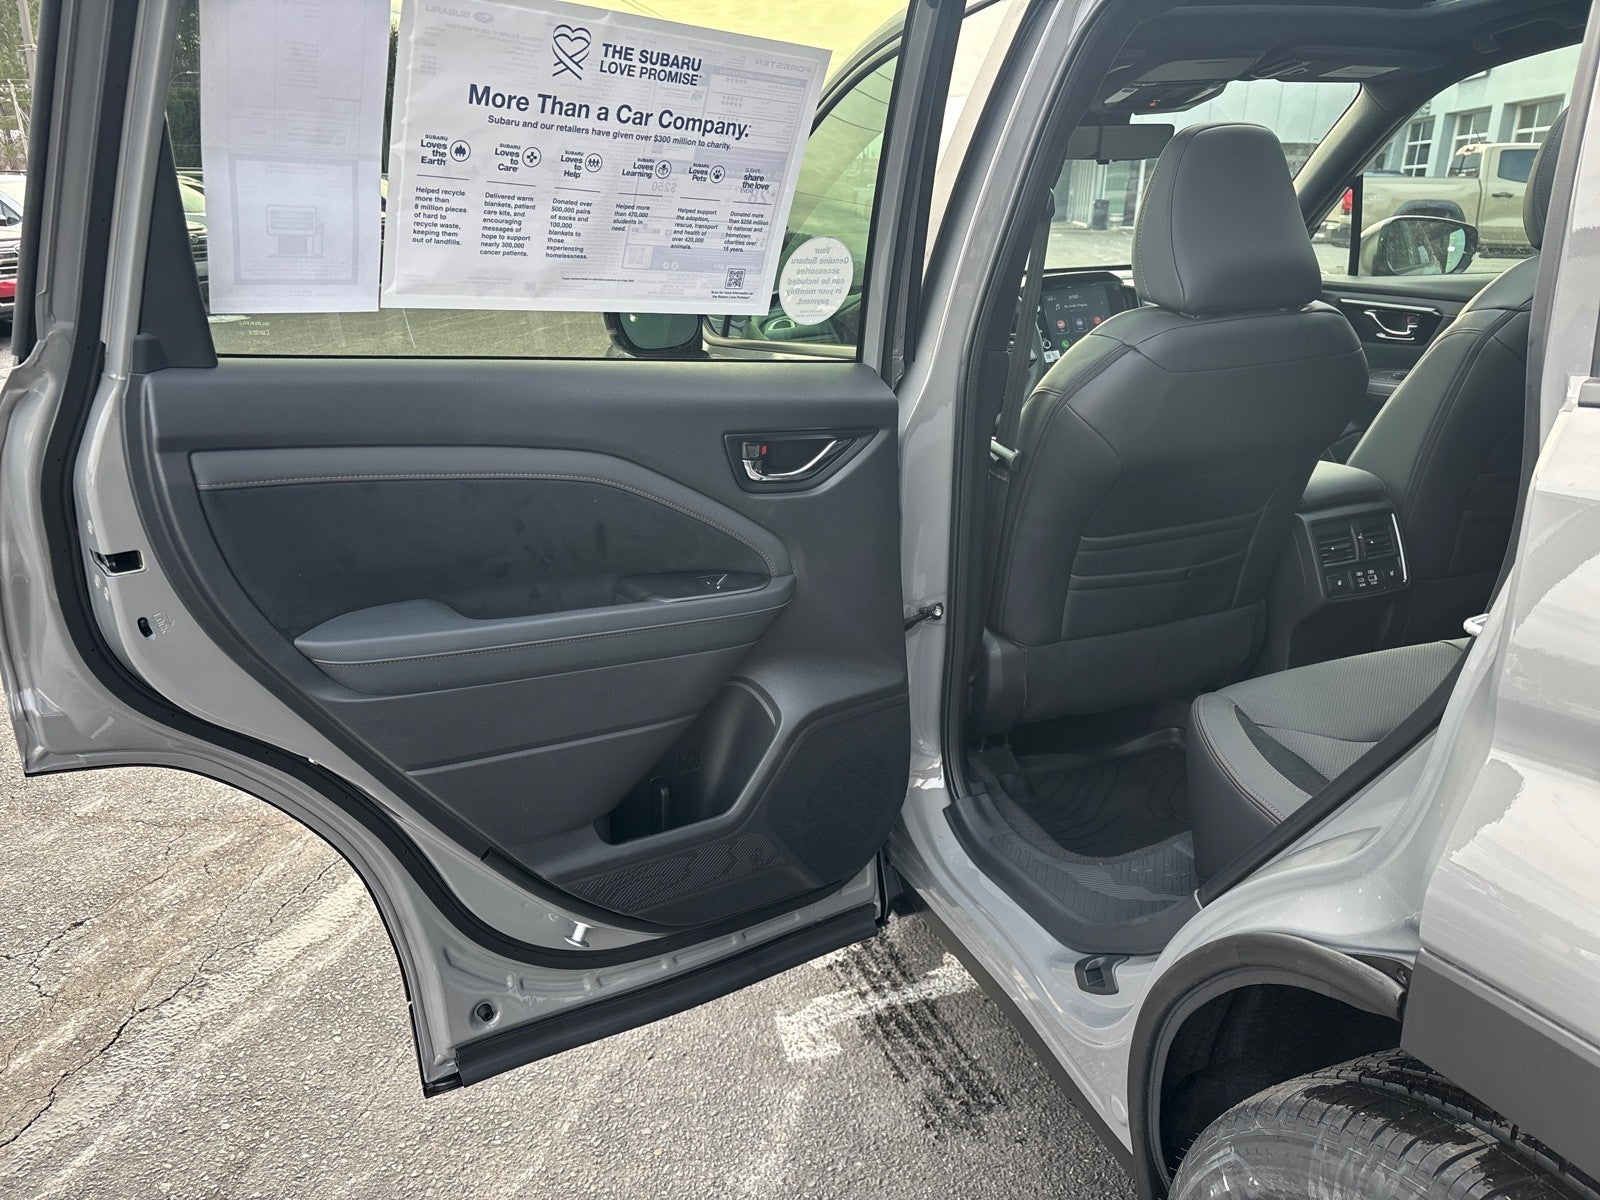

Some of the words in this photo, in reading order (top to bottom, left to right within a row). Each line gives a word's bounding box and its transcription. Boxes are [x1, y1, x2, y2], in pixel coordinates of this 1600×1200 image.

[602, 42, 635, 61] THE
[638, 49, 702, 72] SUBARU
[599, 61, 636, 78] LOVE
[468, 83, 530, 112] More
[537, 92, 590, 119] Than
[596, 105, 609, 122] a
[615, 103, 653, 127] Car
[487, 114, 521, 127] Subaru
[522, 119, 538, 130] and
[556, 122, 590, 135] retailers
[591, 127, 611, 138] have
[612, 130, 633, 141] given
[635, 134, 652, 143] over
[653, 133, 671, 144] $300
[672, 136, 697, 147] million
[698, 139, 705, 147] to
[706, 139, 732, 151] charity.
[420, 139, 448, 150] Loves
[432, 149, 447, 158] the
[494, 148, 520, 158] Loves
[420, 156, 447, 166] Earth
[560, 155, 583, 164] Loves
[497, 163, 519, 172] Care
[574, 163, 582, 171] to
[633, 162, 654, 171] Loves
[563, 170, 581, 179] Help
[621, 169, 653, 179] Learning
[688, 167, 709, 176] Loves
[743, 173, 765, 182] share
[741, 180, 754, 189] the
[754, 181, 770, 191] love
[415, 187, 440, 196] Helped
[441, 188, 466, 197] recycle
[485, 192, 515, 201] Delivered
[434, 196, 450, 204] than
[552, 198, 578, 206] Donated
[420, 203, 445, 212] million
[445, 205, 467, 214] pieces
[484, 200, 513, 209] blankets,
[514, 203, 536, 211] patient
[615, 203, 635, 211] Helped
[499, 209, 512, 217] kits,
[551, 206, 575, 214] 500,000
[575, 207, 591, 215] pairs
[422, 212, 439, 220] hard
[558, 214, 576, 222] socks
[413, 220, 438, 229] recycle
[482, 217, 522, 227] encouraging
[550, 222, 573, 230] 100,000
[412, 229, 440, 239] keeping
[441, 230, 459, 238] them
[481, 225, 514, 234] messages
[548, 229, 574, 237] blankets
[433, 238, 462, 247] landfills.
[481, 233, 498, 242] hope
[506, 235, 531, 243] support
[480, 241, 500, 250] nearly
[501, 242, 525, 250] 300,000
[546, 245, 584, 253] experiencing
[502, 249, 528, 258] patients.
[545, 252, 588, 260] homelessness.
